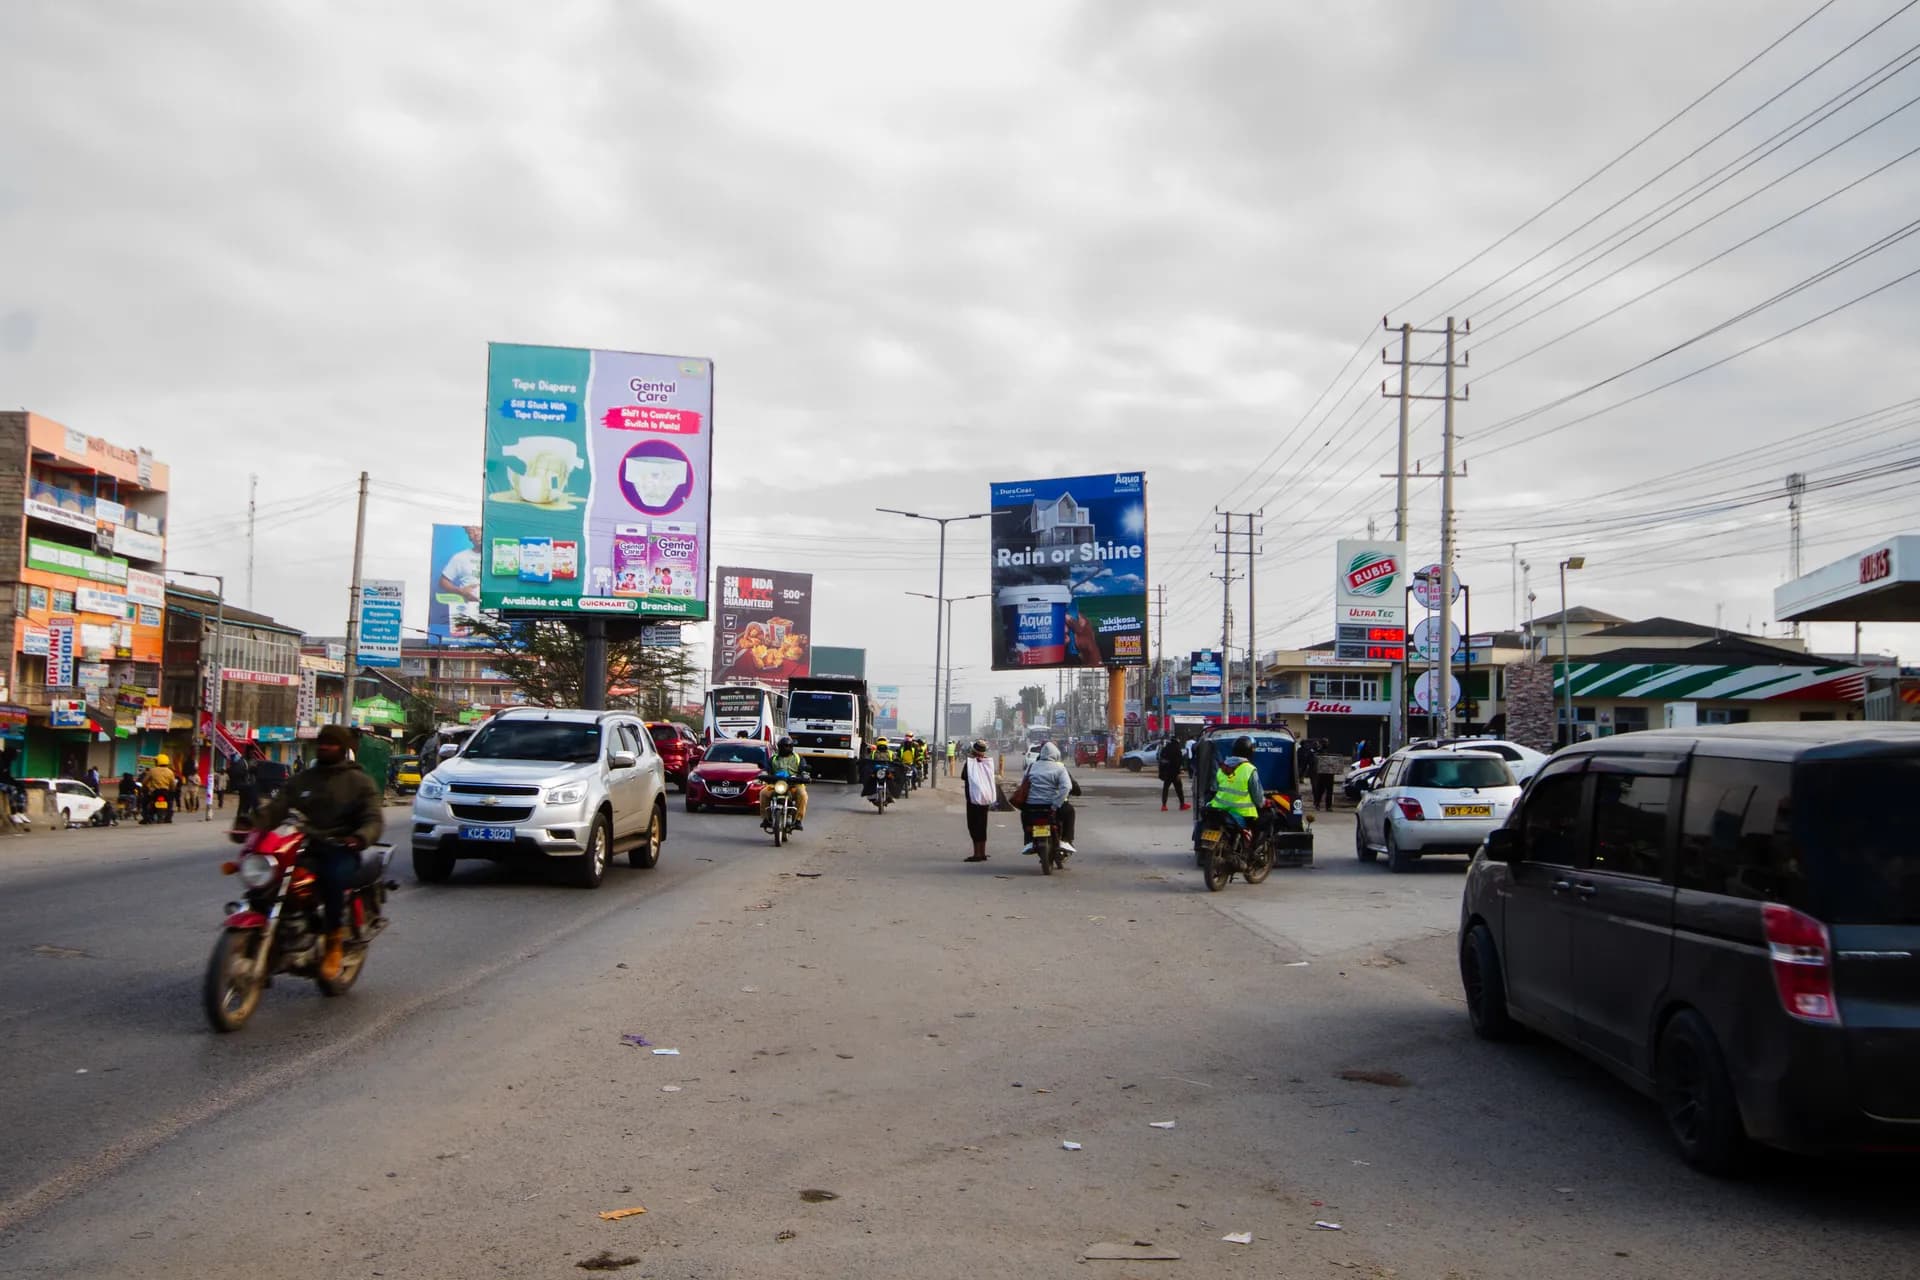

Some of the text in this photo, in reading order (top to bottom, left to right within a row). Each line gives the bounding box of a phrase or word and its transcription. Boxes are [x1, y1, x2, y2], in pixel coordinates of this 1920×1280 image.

[512, 378, 577, 394] Tape Diapers
[630, 378, 676, 393] Gental
[637, 391, 668, 403] Care
[510, 399, 567, 411] Still Stuck With
[514, 409, 532, 420] Tape
[621, 408, 640, 417] Shift
[640, 409, 648, 418] to
[624, 419, 650, 429] Switch
[650, 421, 658, 429] to
[1115, 474, 1140, 485] Aqua
[658, 538, 694, 551] Gental
[664, 548, 688, 558] Care
[997, 541, 1142, 567] Rain or Shine
[501, 596, 573, 607] Available at all
[641, 601, 687, 612] Branches!
[1020, 614, 1053, 629] Aqua
[48, 626, 73, 685] DRIVING SCHOOL
[1304, 700, 1353, 713] Bata
